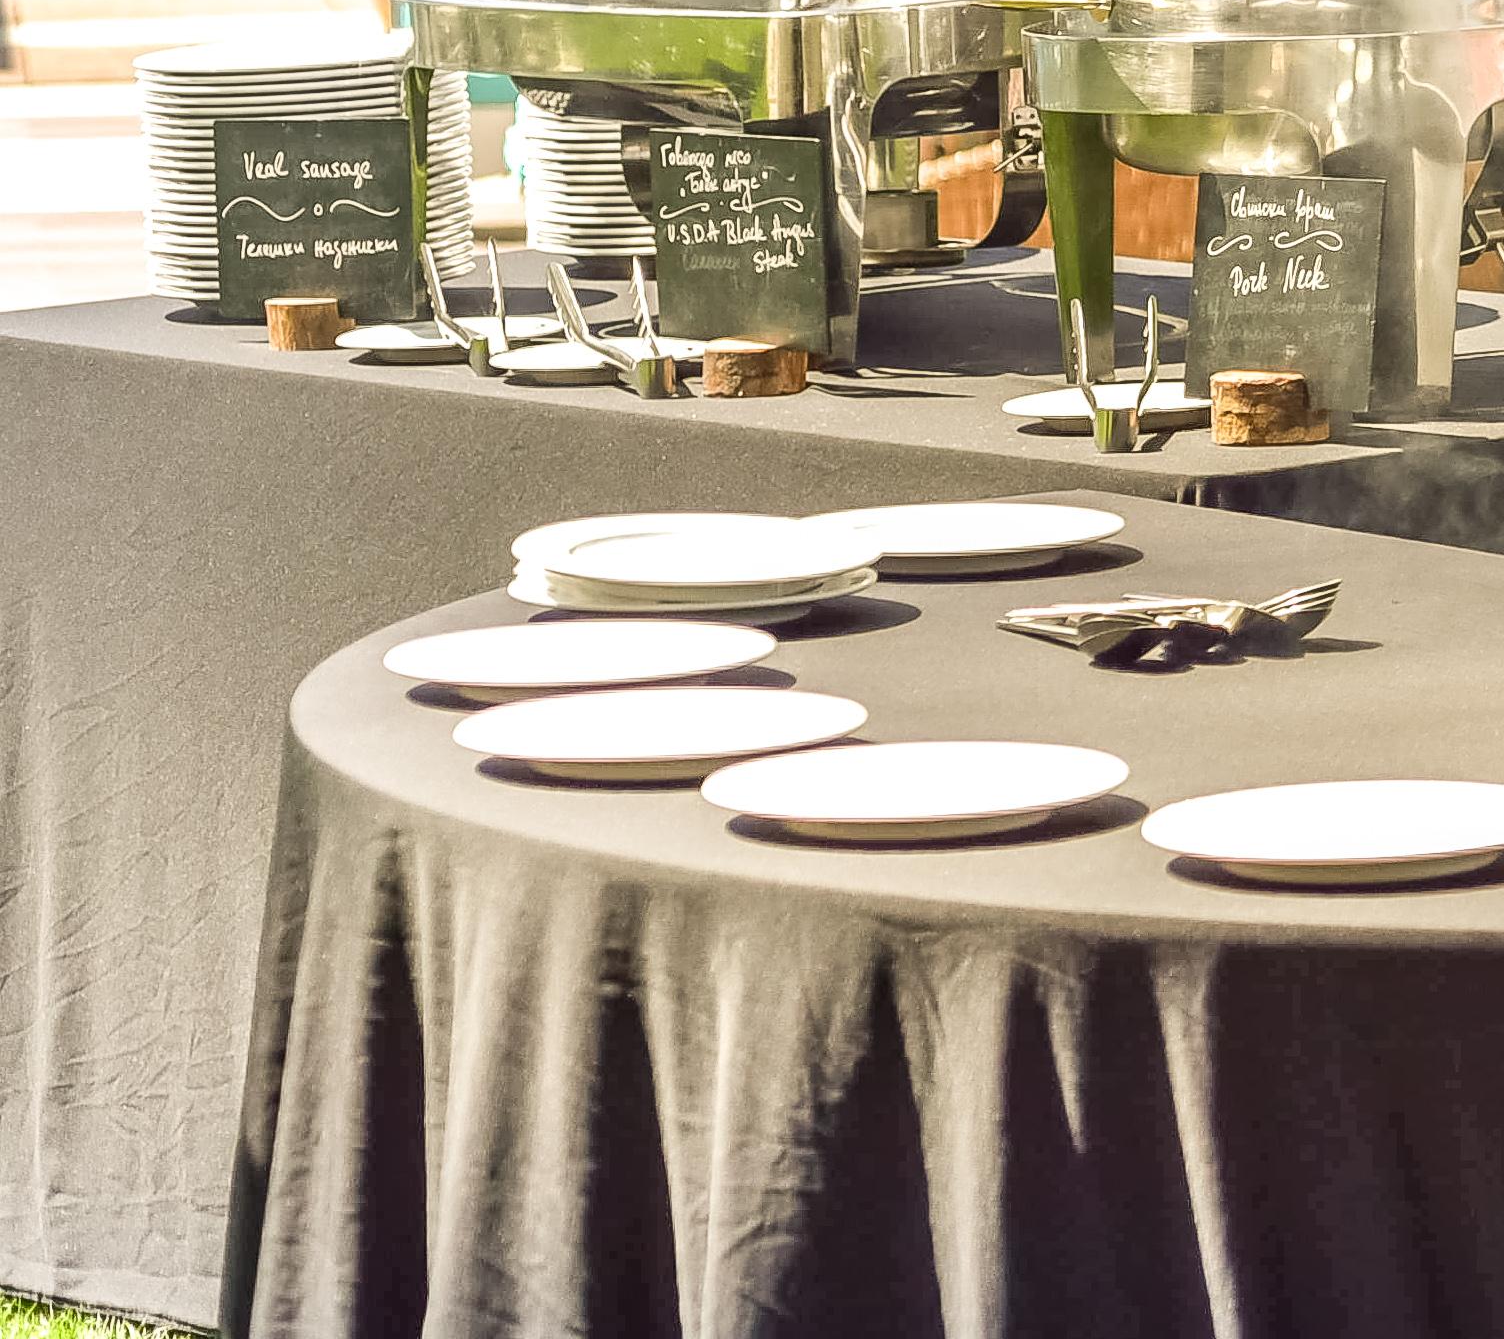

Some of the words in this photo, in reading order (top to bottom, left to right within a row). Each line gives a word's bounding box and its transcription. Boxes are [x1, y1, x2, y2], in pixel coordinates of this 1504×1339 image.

[243, 150, 289, 181] Veal
[300, 159, 374, 190] sausage
[720, 214, 769, 245] Black
[771, 213, 816, 257] Angus
[752, 238, 799, 274] Steak
[1229, 261, 1269, 298] Pork
[1282, 253, 1330, 294] Neck
